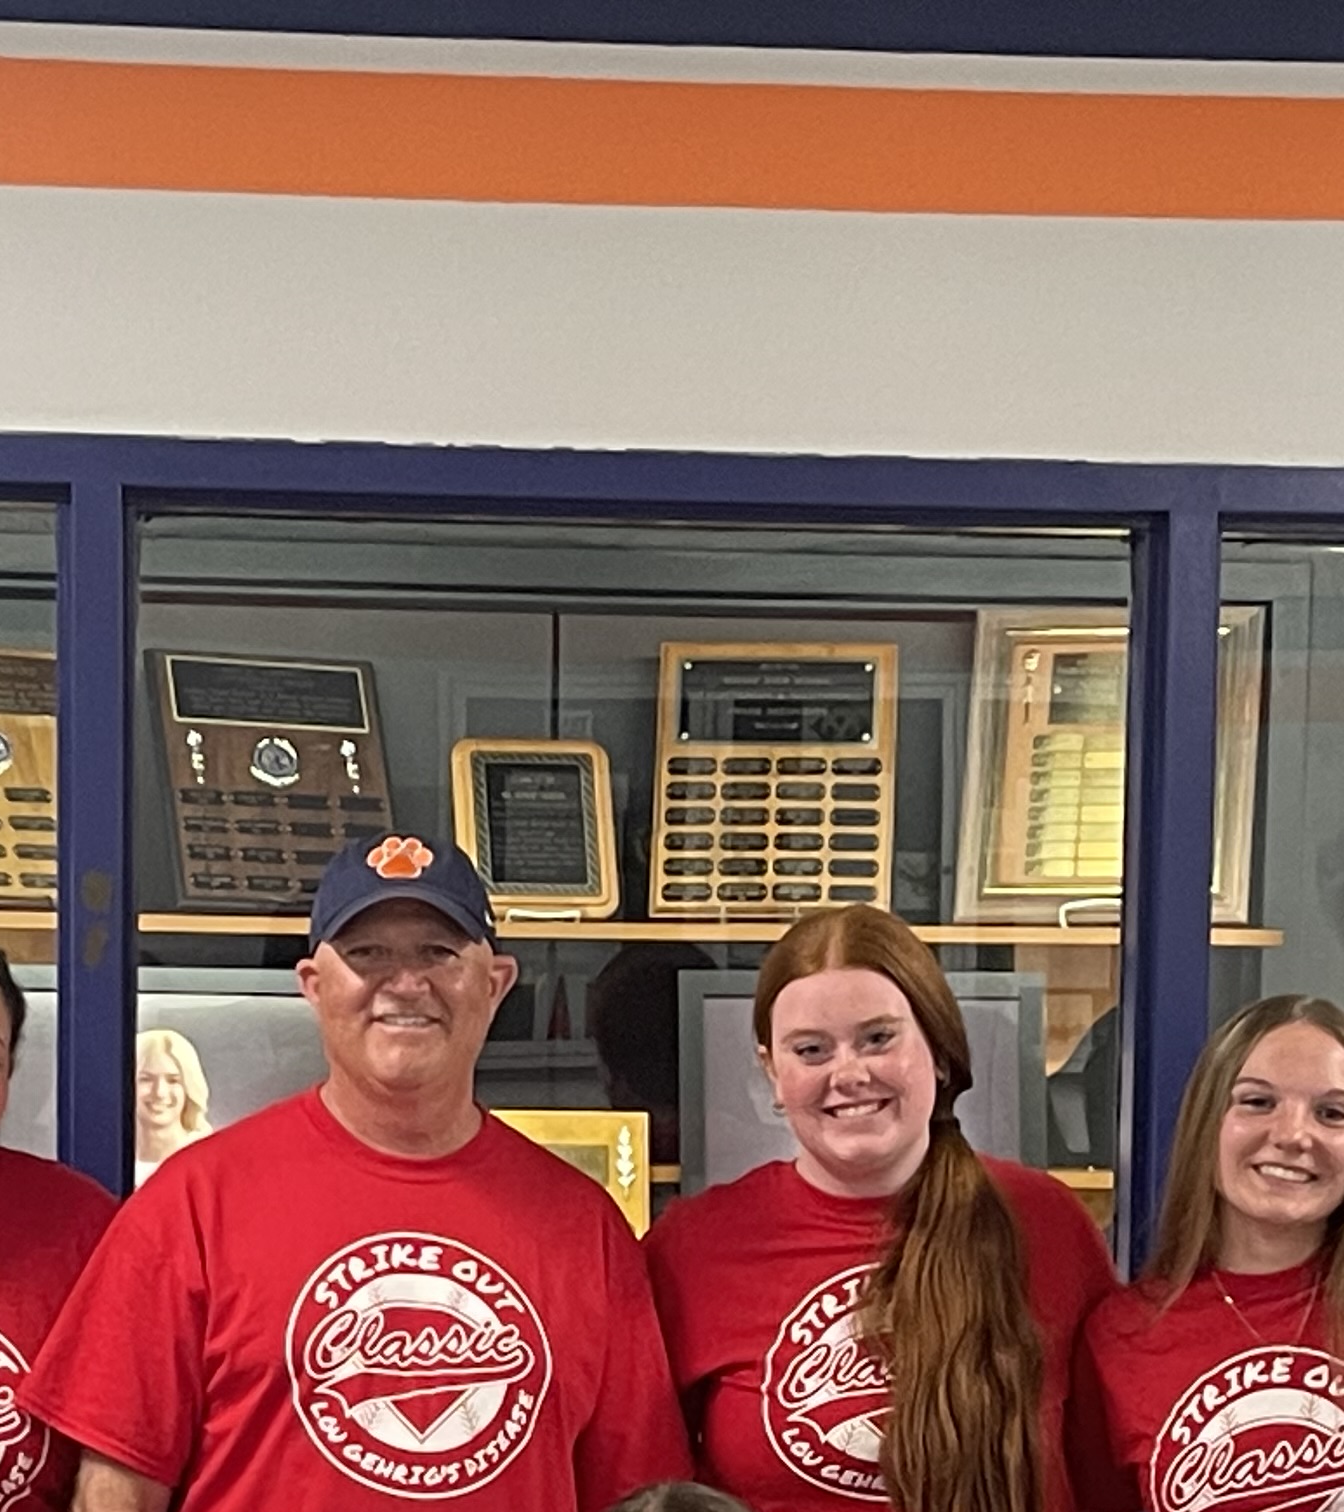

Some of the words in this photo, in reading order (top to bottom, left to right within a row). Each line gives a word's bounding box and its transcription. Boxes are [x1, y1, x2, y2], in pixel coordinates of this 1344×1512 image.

[314, 1242, 444, 1310] STRIKE
[451, 1259, 526, 1314] OUT
[790, 1276, 870, 1346] STRI
[304, 1308, 520, 1381] Classic
[1171, 1356, 1295, 1446] STRIKE
[309, 1401, 348, 1443] LOU
[342, 1443, 462, 1488] GEHRIG'S
[463, 1388, 535, 1478] DISEASE
[781, 1427, 824, 1468] LOU
